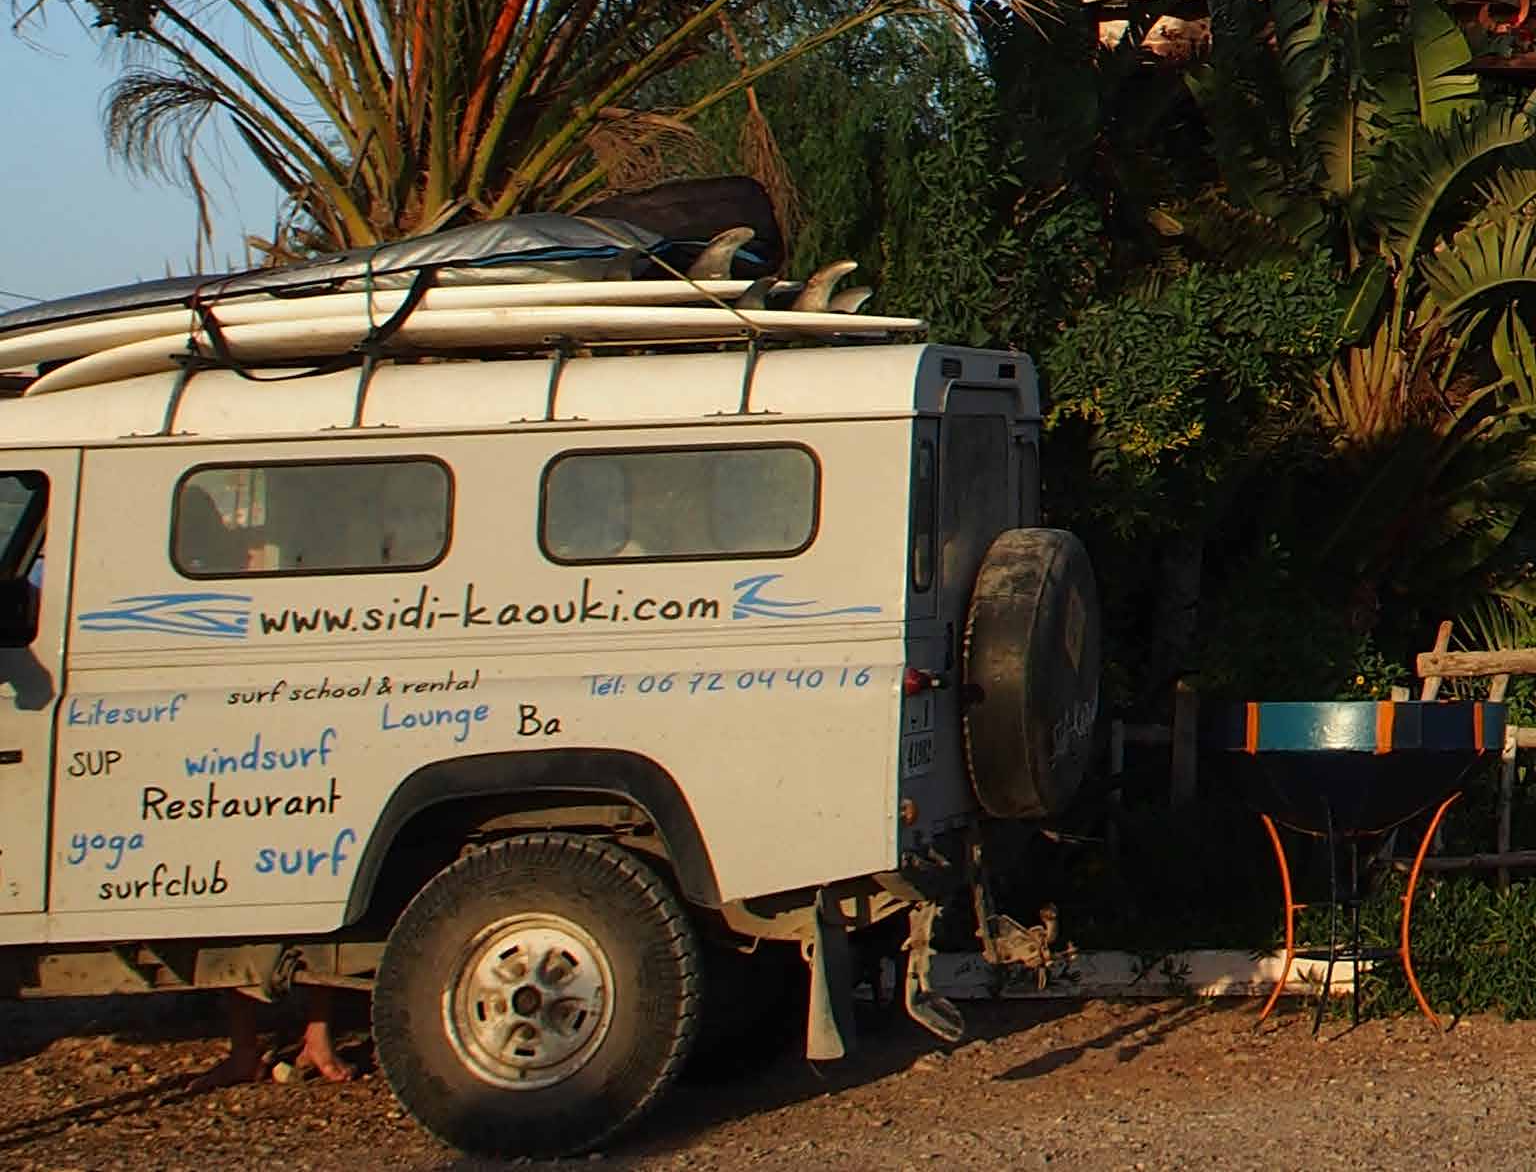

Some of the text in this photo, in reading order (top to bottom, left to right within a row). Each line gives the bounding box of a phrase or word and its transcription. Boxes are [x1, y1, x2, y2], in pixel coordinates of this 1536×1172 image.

[259, 578, 720, 635] www.sidi-kaouki.com
[227, 669, 480, 705] surf school & rental
[637, 674, 675, 693] 06
[687, 672, 725, 694] 72
[735, 670, 777, 690] 04
[785, 668, 824, 688] 40
[839, 666, 872, 688] 16
[67, 694, 187, 726] kitesurf
[382, 704, 489, 743] Lounge
[517, 704, 562, 737] Ba
[67, 750, 122, 778] SUP
[185, 727, 337, 778] windsurf
[141, 777, 342, 821] Restaurant
[67, 832, 145, 871] yoga
[254, 828, 357, 876] surf
[98, 860, 229, 901] surfclub
